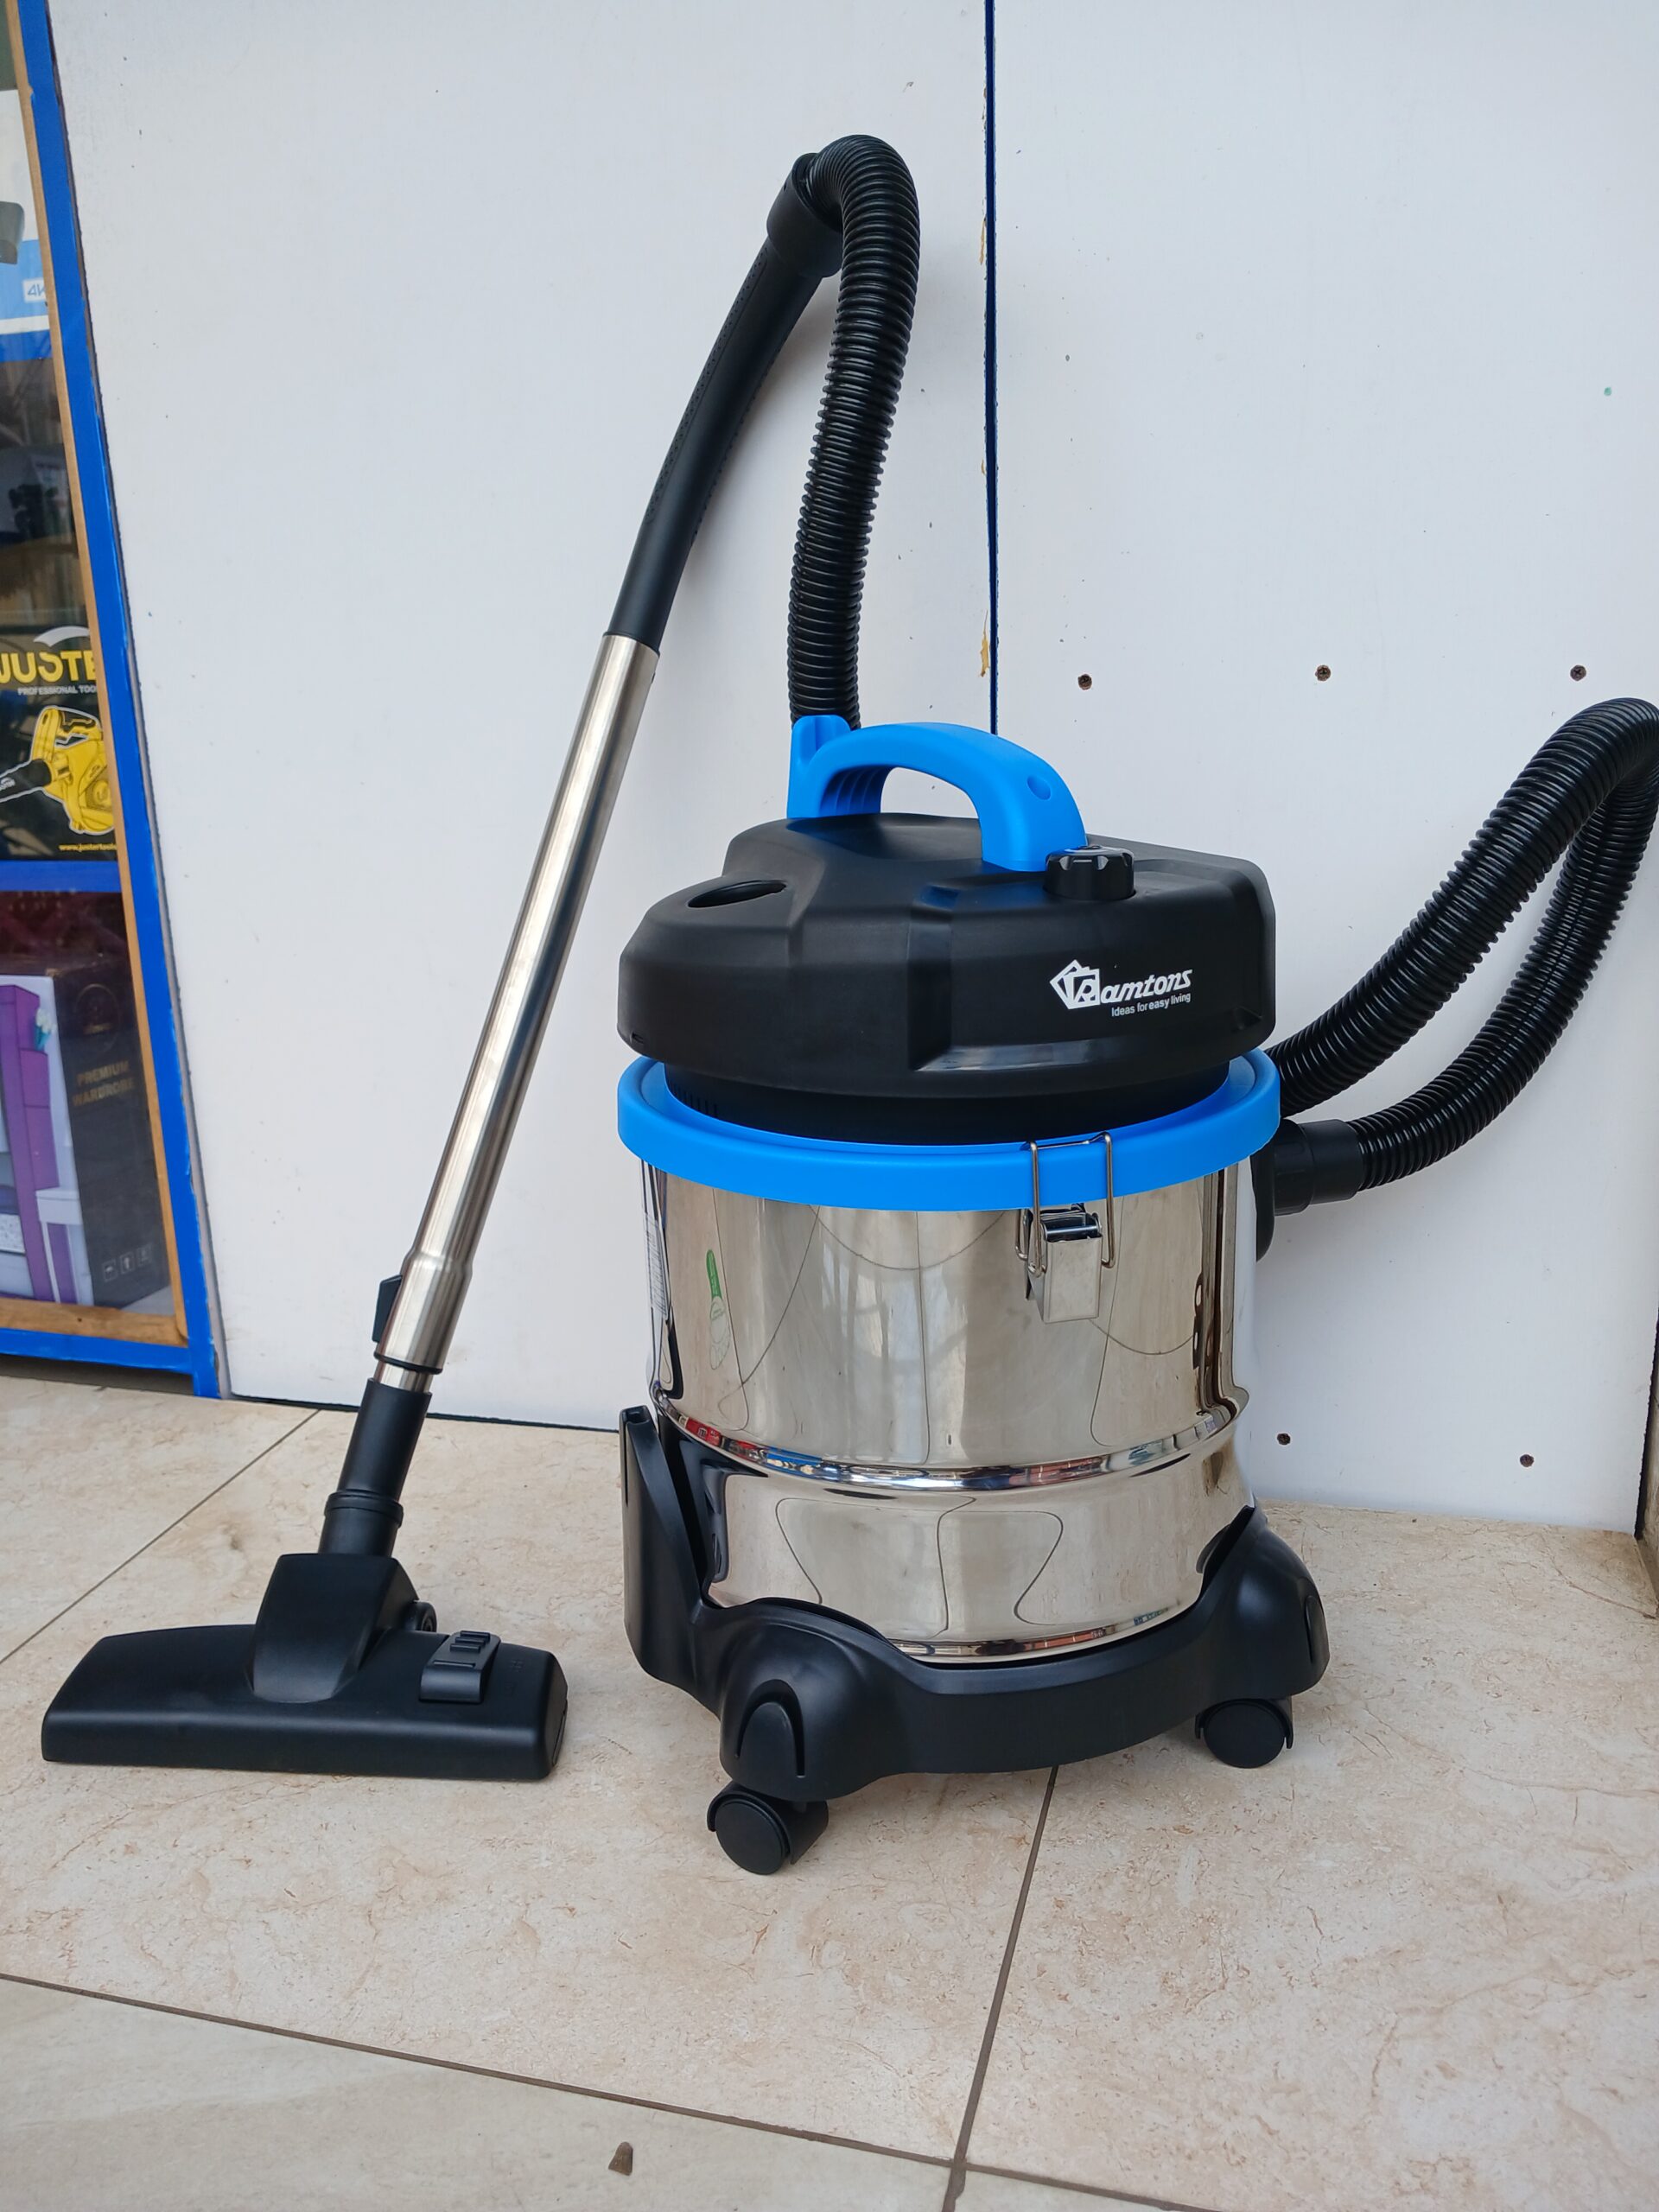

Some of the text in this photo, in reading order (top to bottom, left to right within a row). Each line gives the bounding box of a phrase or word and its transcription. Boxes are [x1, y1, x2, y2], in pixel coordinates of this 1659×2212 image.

[1111, 992, 1192, 1017] Ideas for easy living
